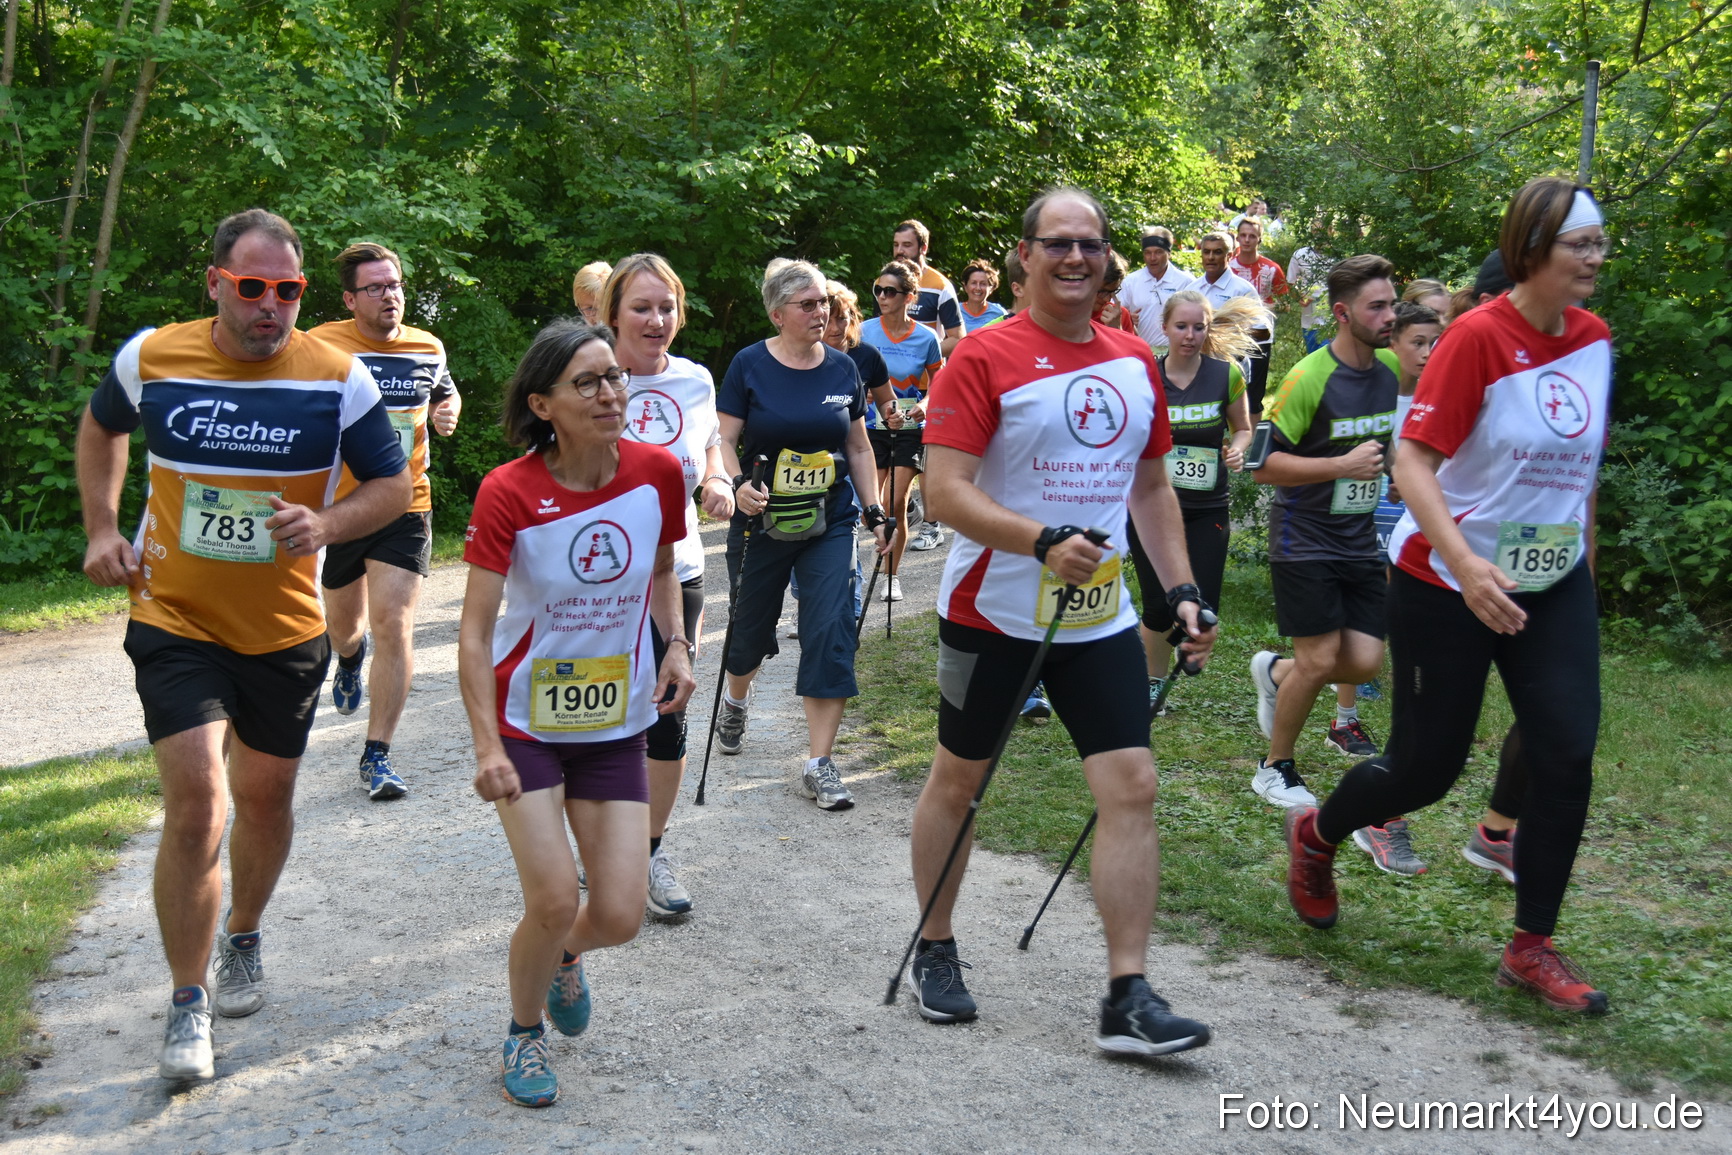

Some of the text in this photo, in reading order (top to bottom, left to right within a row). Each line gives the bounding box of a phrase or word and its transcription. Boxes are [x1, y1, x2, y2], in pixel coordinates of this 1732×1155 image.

[1167, 403, 1220, 422] OCK
[190, 416, 301, 443] Fischer
[1332, 414, 1395, 438] BOC
[200, 440, 291, 454] AUTOMOBILE
[1033, 456, 1084, 472] LAUFEN
[1090, 463, 1110, 472] MIT
[1175, 461, 1207, 479] 339
[783, 467, 827, 485] 1411
[1044, 479, 1059, 487] Dr.
[1061, 480, 1085, 488] Heck
[1093, 480, 1105, 488] Dr.
[1347, 482, 1377, 501] 319
[200, 511, 255, 543] 783
[197, 537, 257, 551] Siebald Thomas
[1507, 547, 1569, 572] 1896
[592, 598, 613, 606] MIT
[1052, 580, 1114, 611] 1907
[545, 682, 617, 711] 1900
[583, 711, 608, 719] Renate
